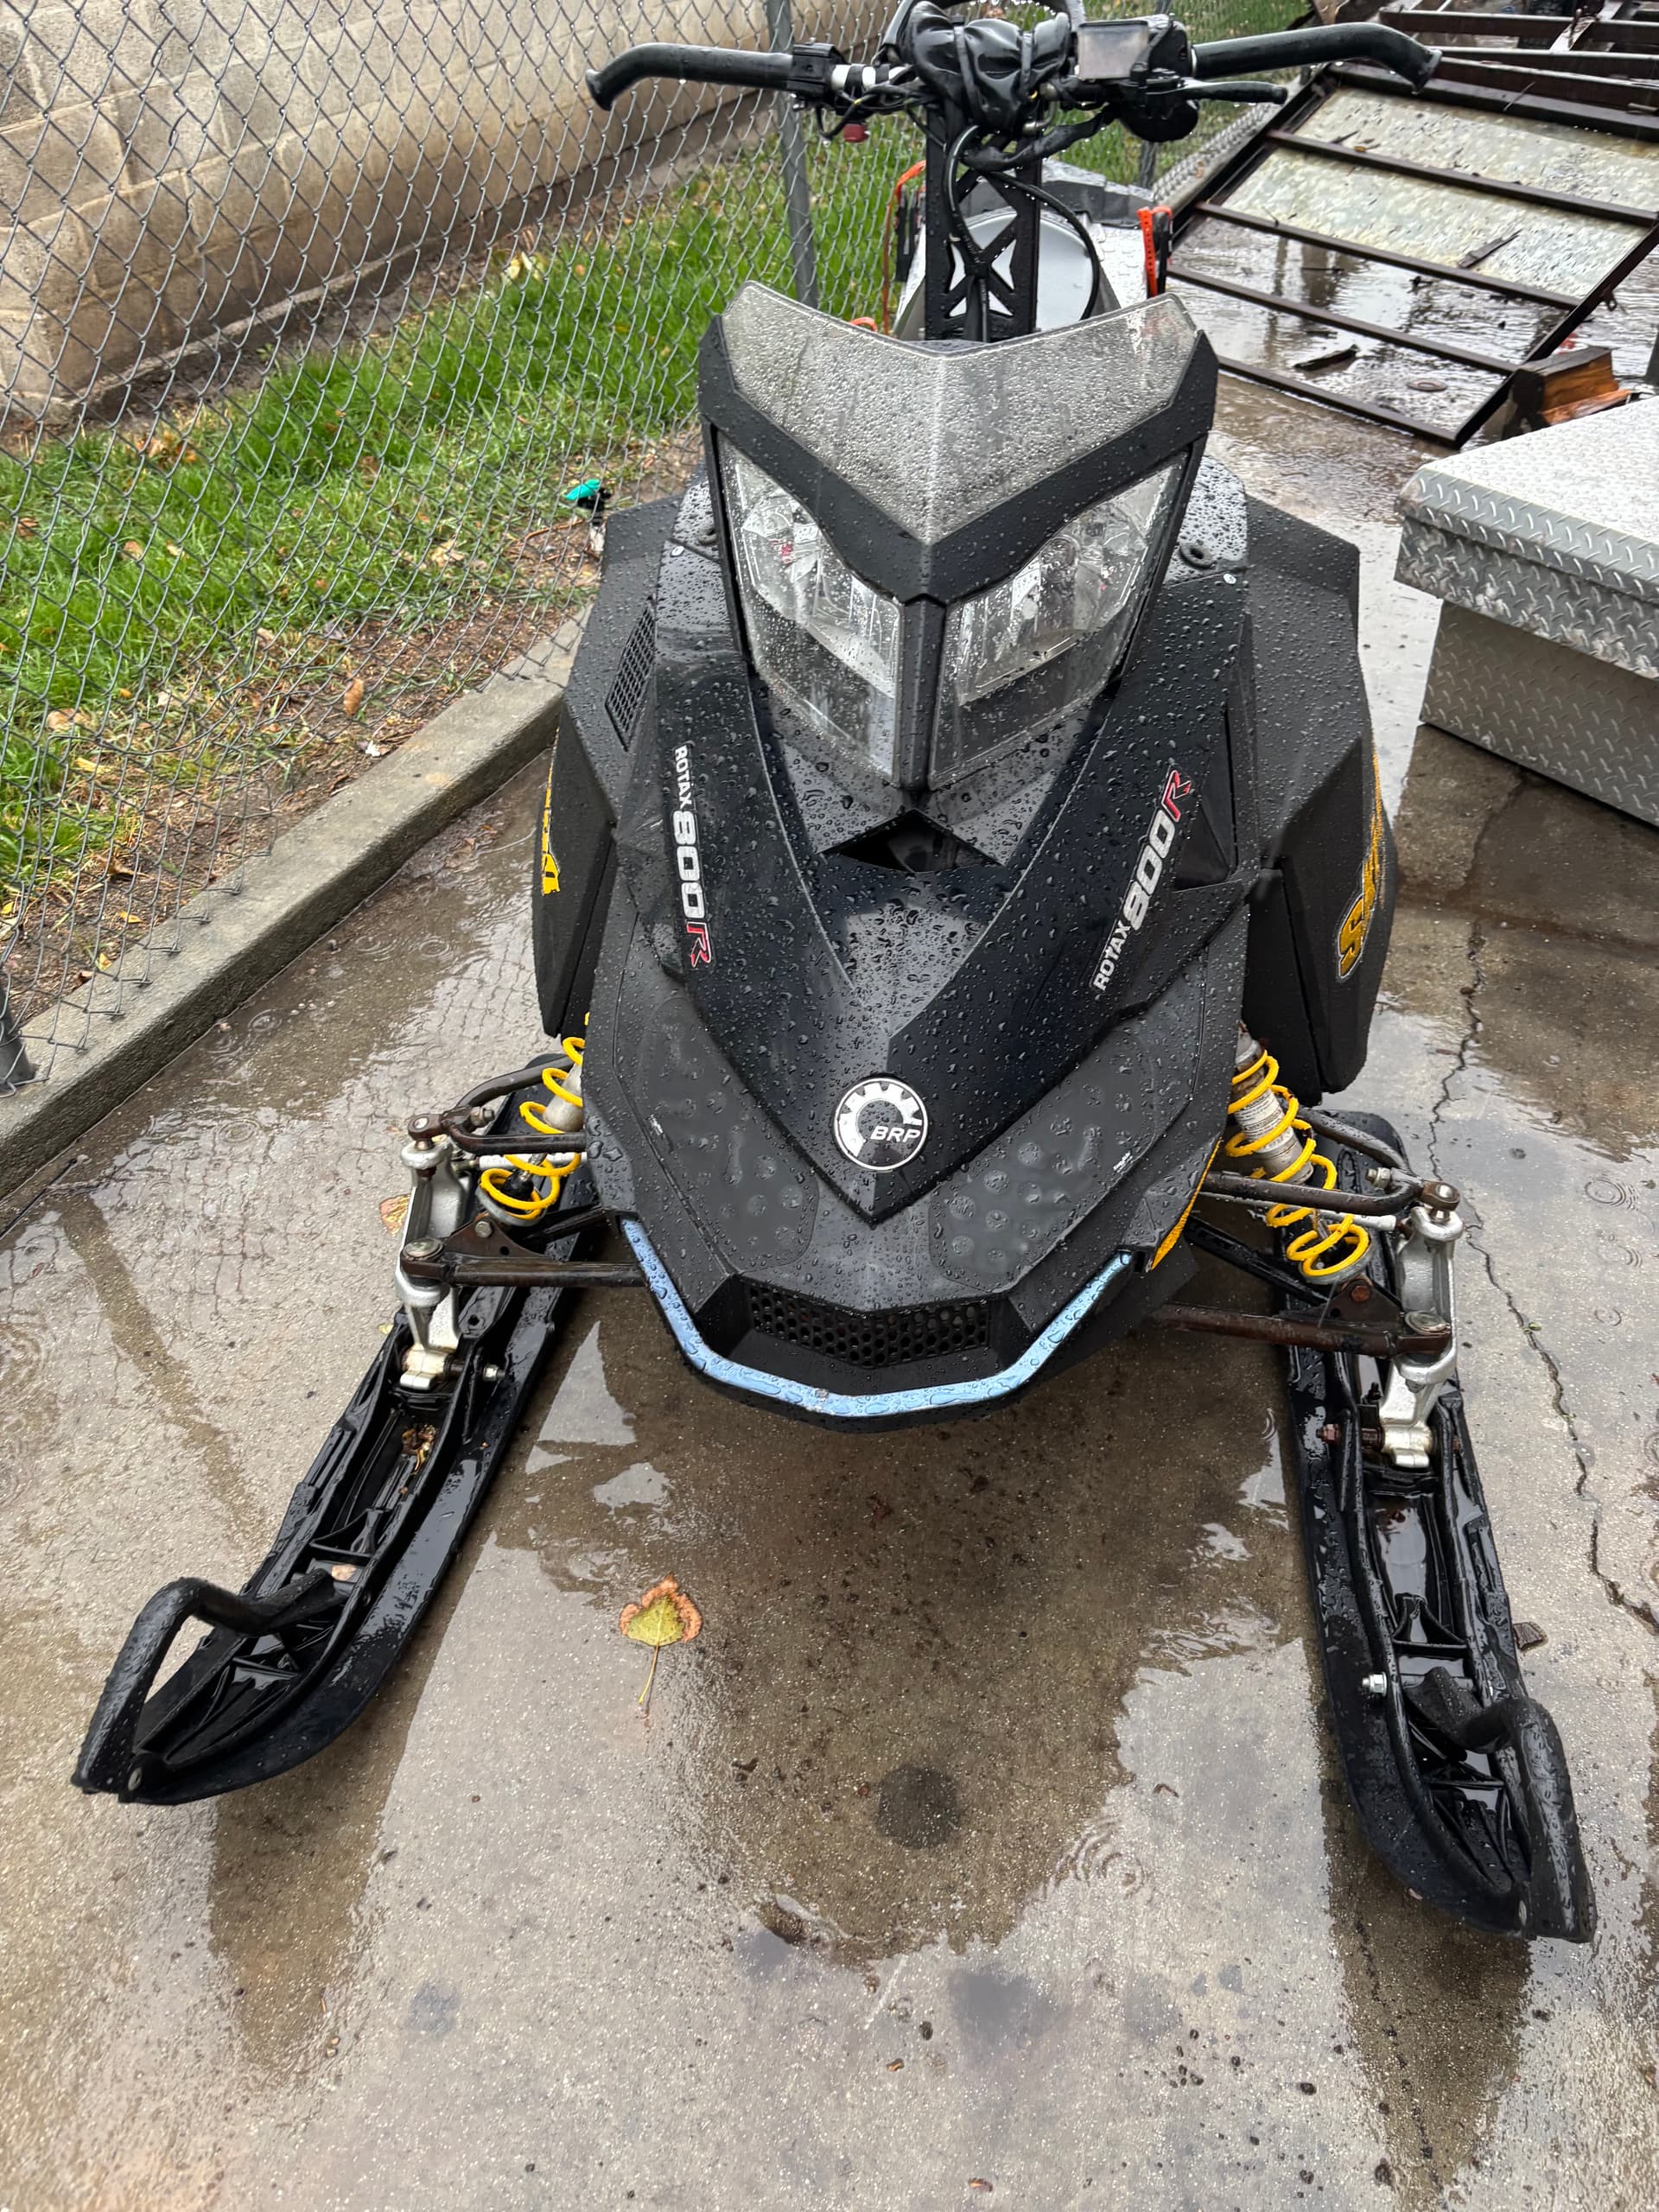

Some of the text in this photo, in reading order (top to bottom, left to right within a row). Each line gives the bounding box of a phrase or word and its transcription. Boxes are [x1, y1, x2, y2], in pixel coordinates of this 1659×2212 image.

[674, 744, 693, 809] ROTAX
[1092, 920, 1132, 991] ROTAX
[870, 1125, 921, 1143] BRP
